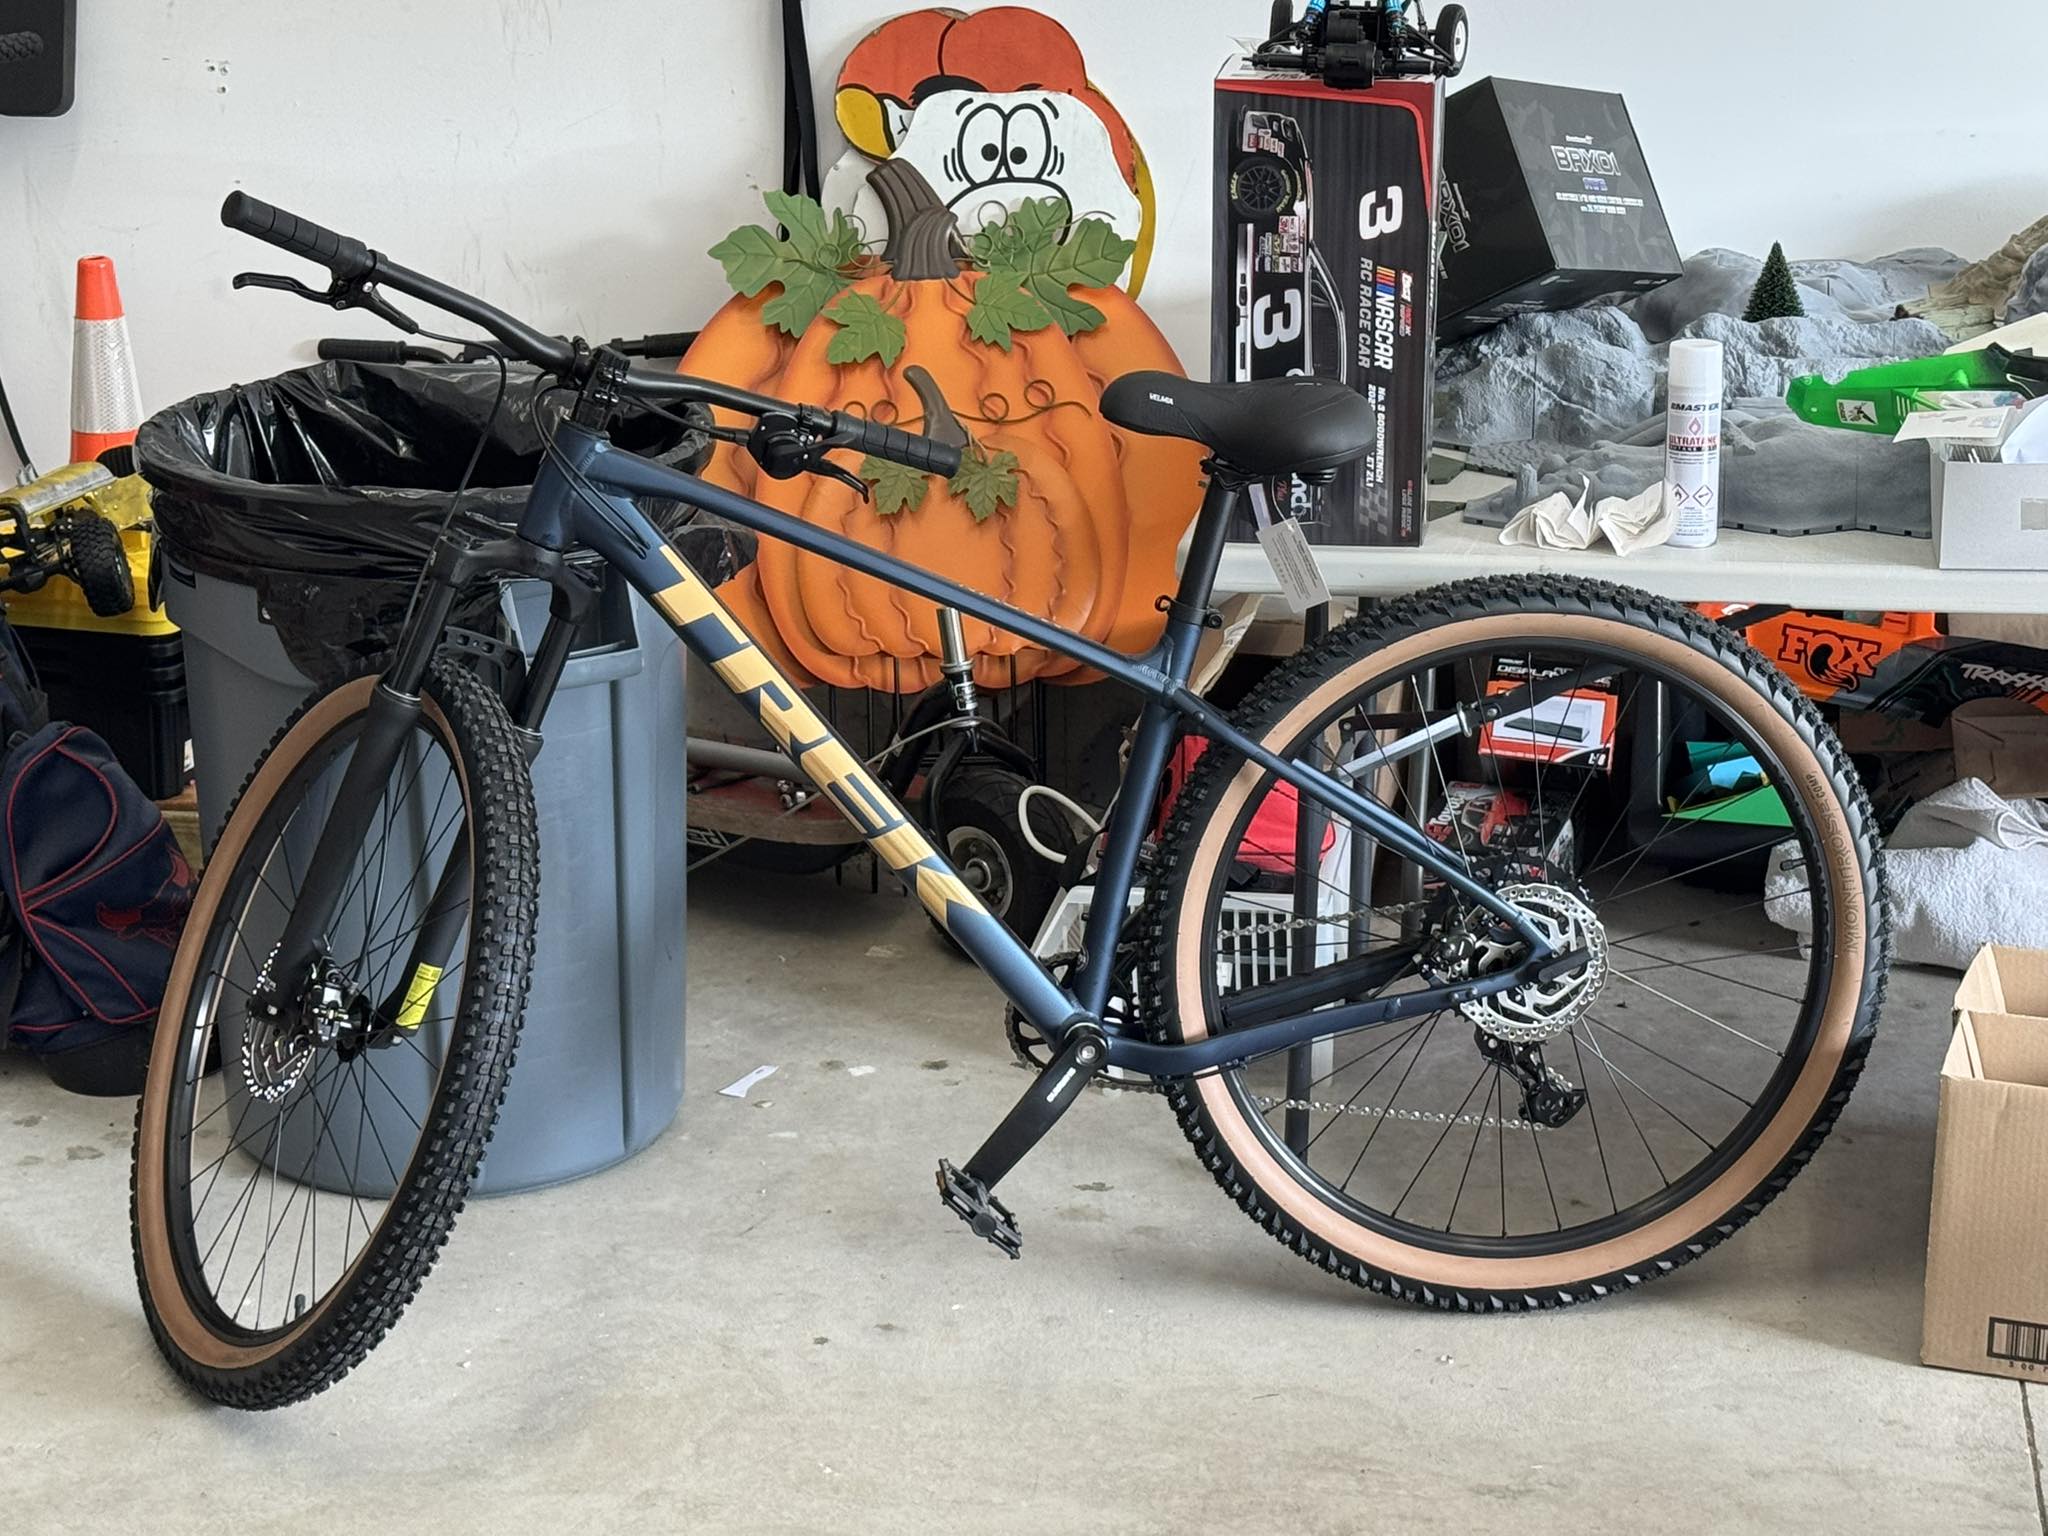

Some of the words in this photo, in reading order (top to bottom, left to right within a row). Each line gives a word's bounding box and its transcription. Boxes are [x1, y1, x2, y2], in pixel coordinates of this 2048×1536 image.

[1551, 145, 1621, 176] BRX01
[1359, 186, 1403, 240] 3
[1360, 257, 1373, 281] RC
[1252, 289, 1302, 350] 3
[1359, 284, 1372, 331] RACE
[1373, 291, 1395, 370] NASCAR
[1357, 333, 1371, 368] CAR
[1375, 412, 1386, 484] GOODWRENCH
[1778, 624, 1881, 692] FOX
[651, 544, 990, 931] TREK
[1804, 770, 1826, 799] COMP
